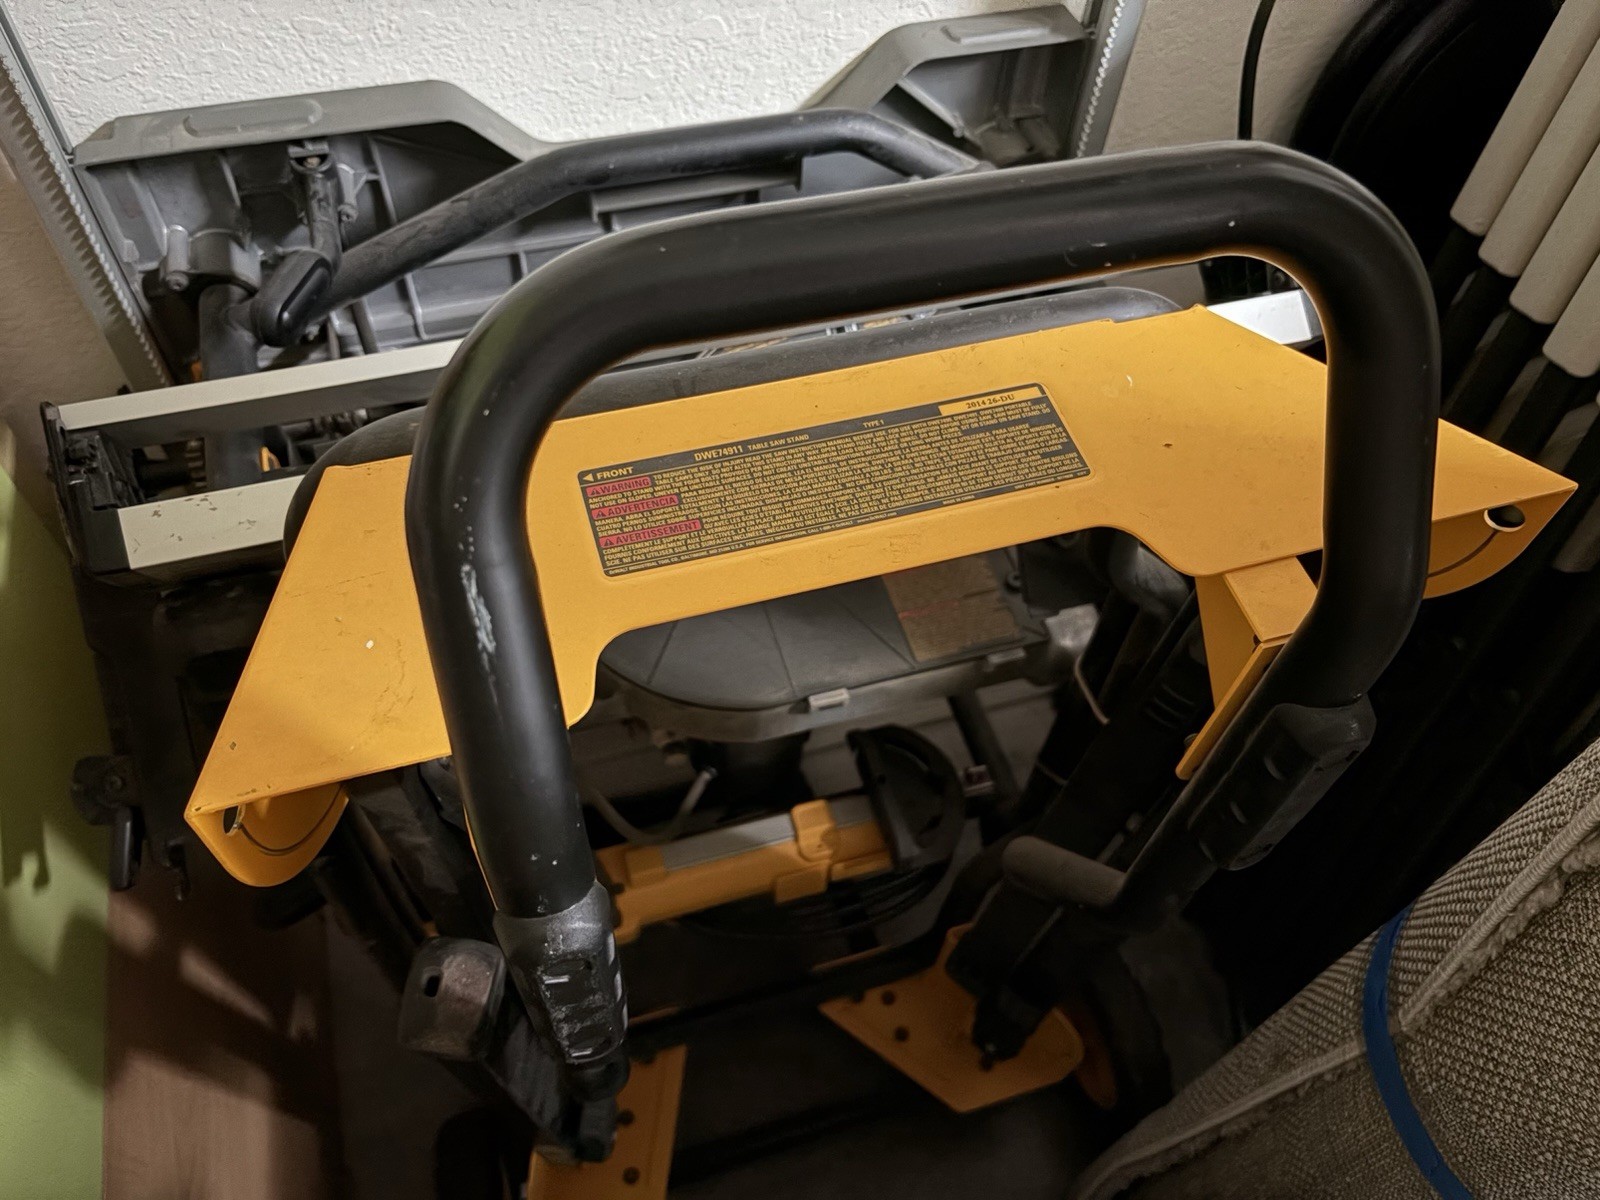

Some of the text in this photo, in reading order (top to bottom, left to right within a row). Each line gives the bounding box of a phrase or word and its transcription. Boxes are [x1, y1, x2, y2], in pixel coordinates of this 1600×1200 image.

[965, 394, 1015, 407] 2014 26-DU
[694, 445, 743, 460] DWE74911
[747, 442, 768, 450] TABLE
[786, 434, 809, 442] STAND
[596, 466, 634, 479] FRONT
[600, 478, 649, 493] WARNING
[607, 496, 676, 516] ADVERTENCIA
[615, 521, 698, 544] AVERTISSEMENT
